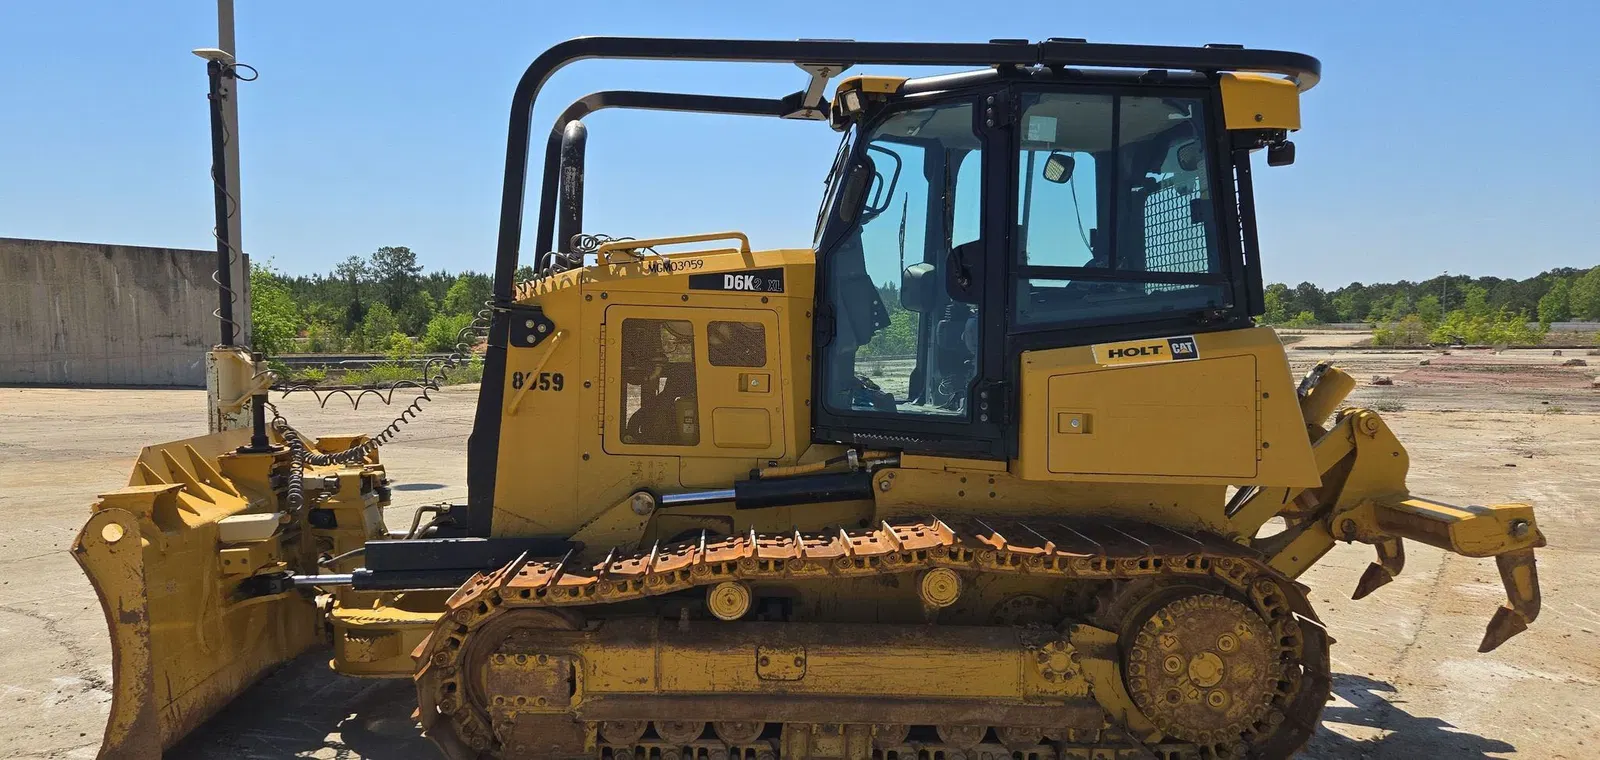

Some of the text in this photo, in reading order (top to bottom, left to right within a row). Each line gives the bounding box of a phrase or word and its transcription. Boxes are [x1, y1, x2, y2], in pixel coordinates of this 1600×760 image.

[767, 279, 782, 292] XL
[1108, 342, 1193, 359] HOLT CAT
